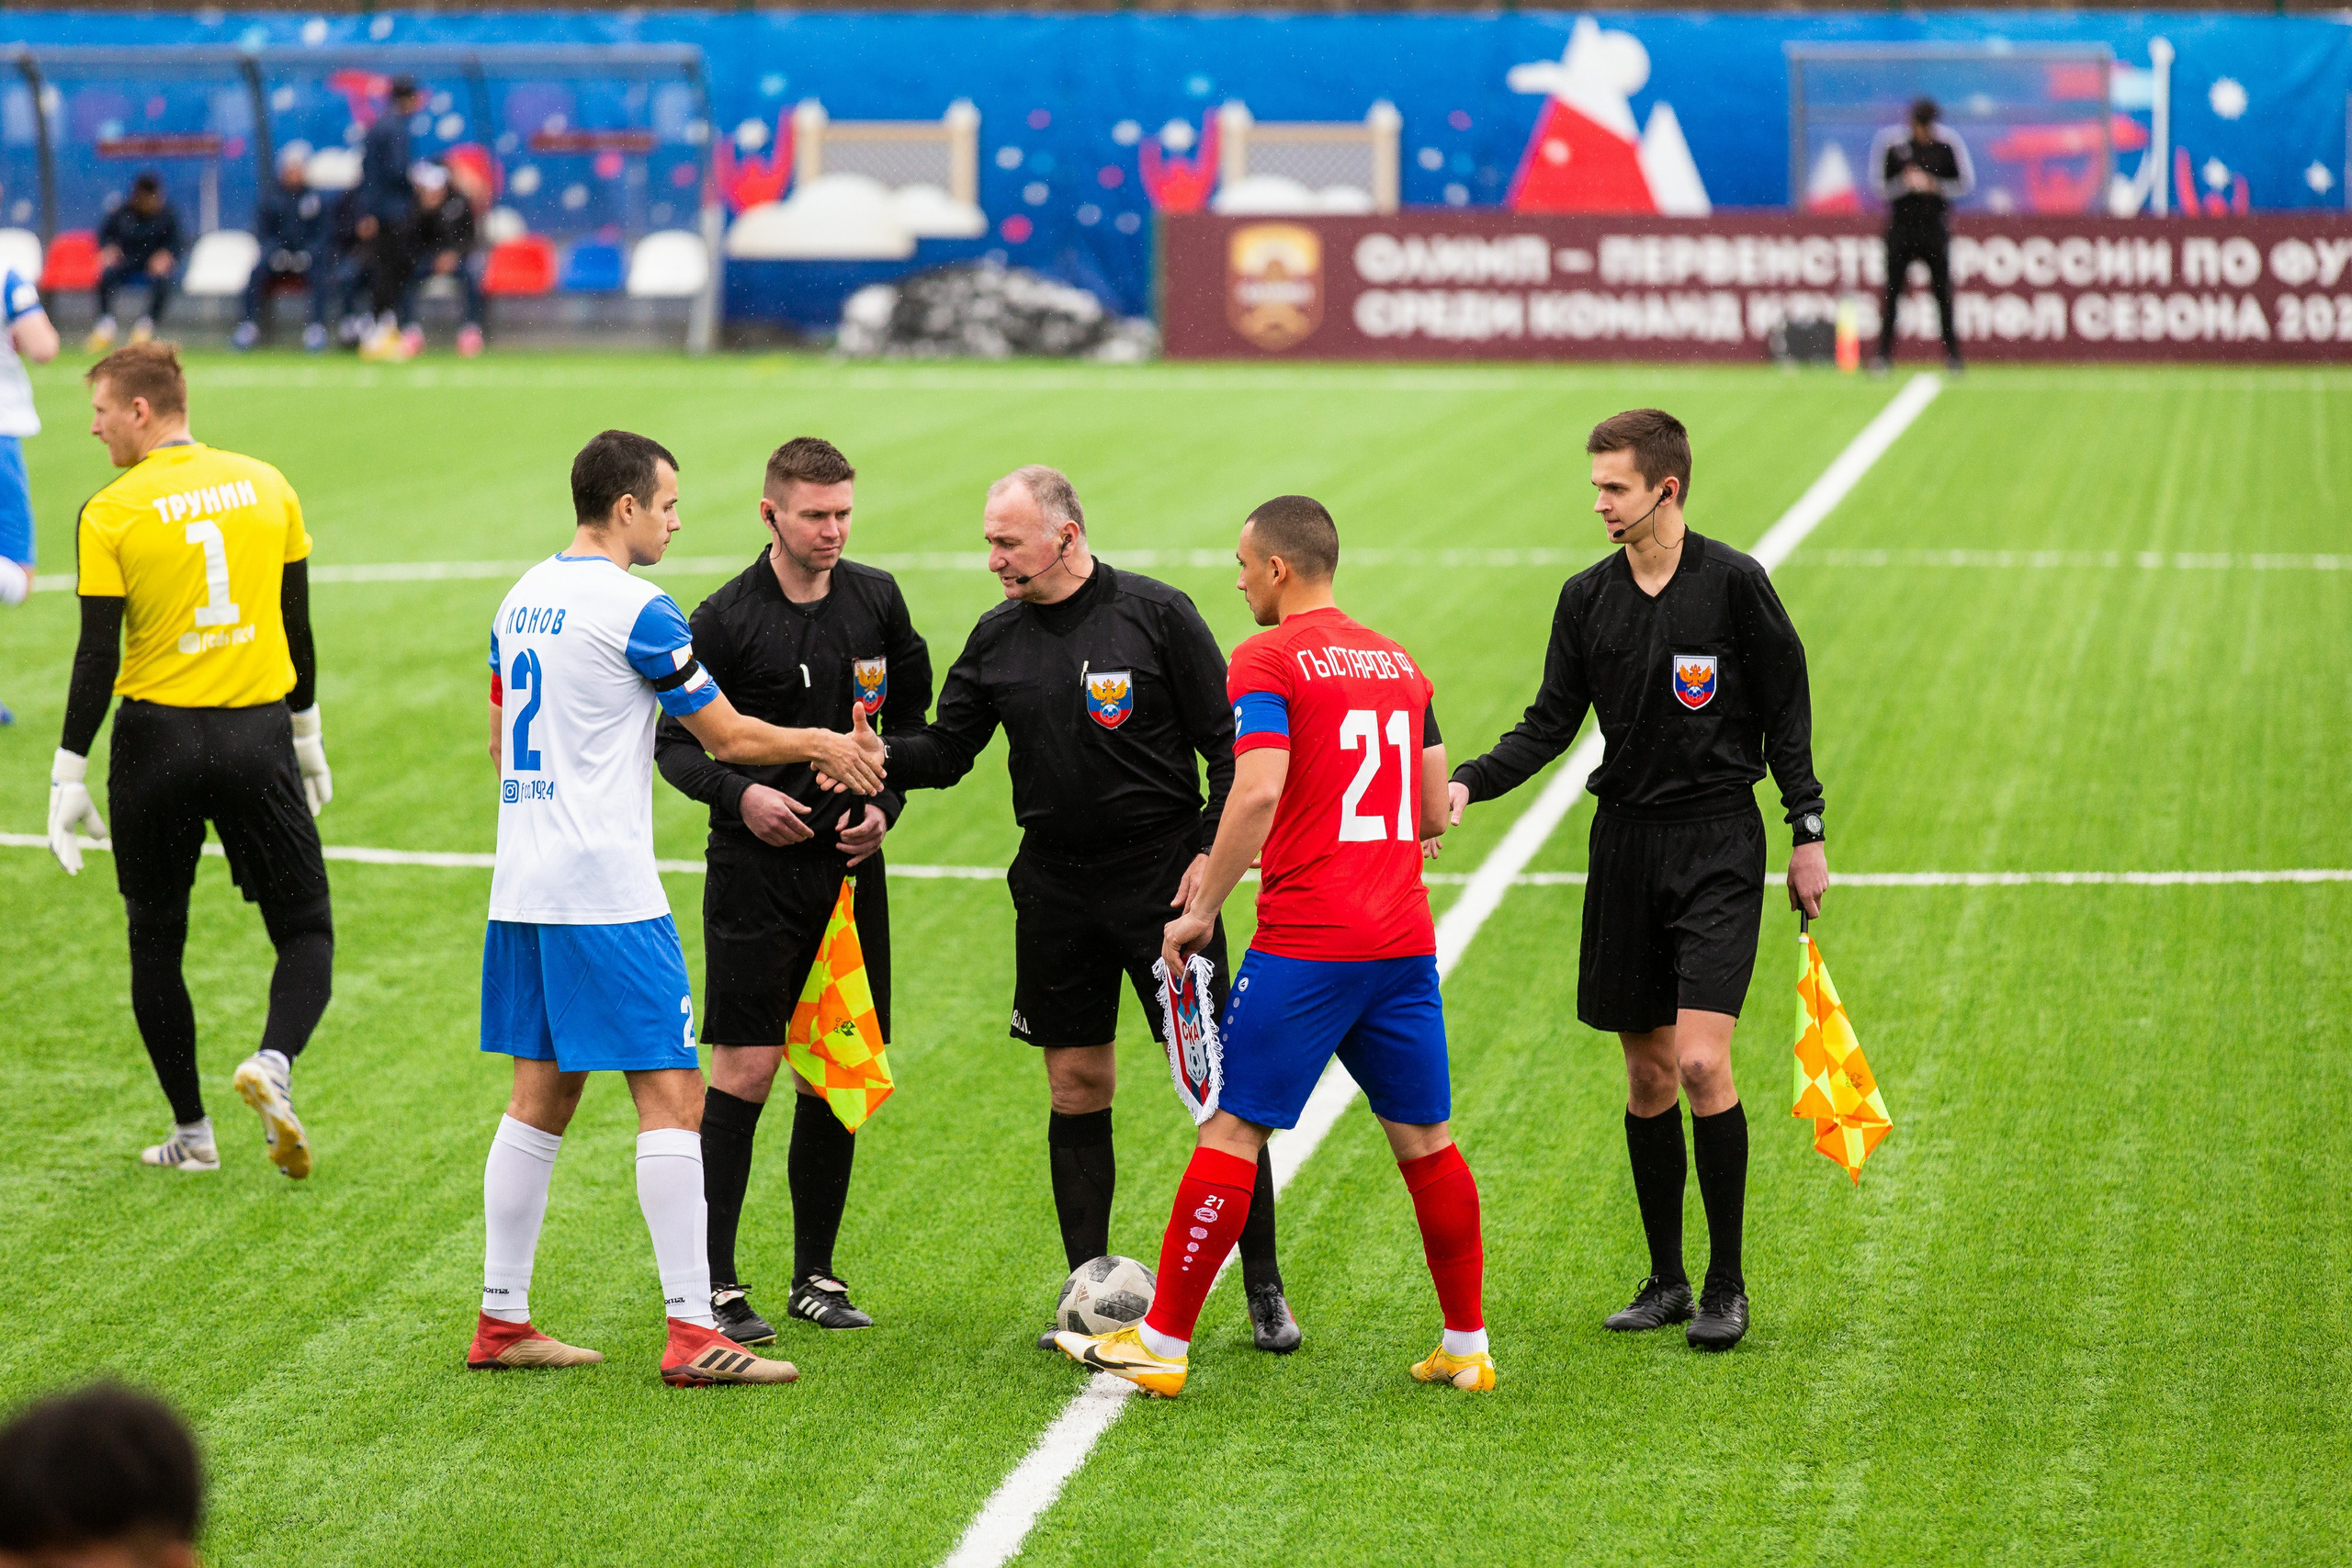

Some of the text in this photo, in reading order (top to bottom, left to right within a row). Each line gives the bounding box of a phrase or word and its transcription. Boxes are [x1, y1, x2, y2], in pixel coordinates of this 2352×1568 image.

[1949, 235, 2173, 287] РОССИИ
[2181, 236, 2262, 287] ПО
[2072, 291, 2271, 342] СЕЗОНА
[152, 479, 257, 524] ТРУНИН
[186, 519, 240, 627] 1
[511, 648, 542, 771] 2
[1339, 709, 1414, 841] 21
[680, 995, 696, 1047] 2
[1182, 1021, 1200, 1045] СКА
[1204, 1194, 1226, 1210] 21
